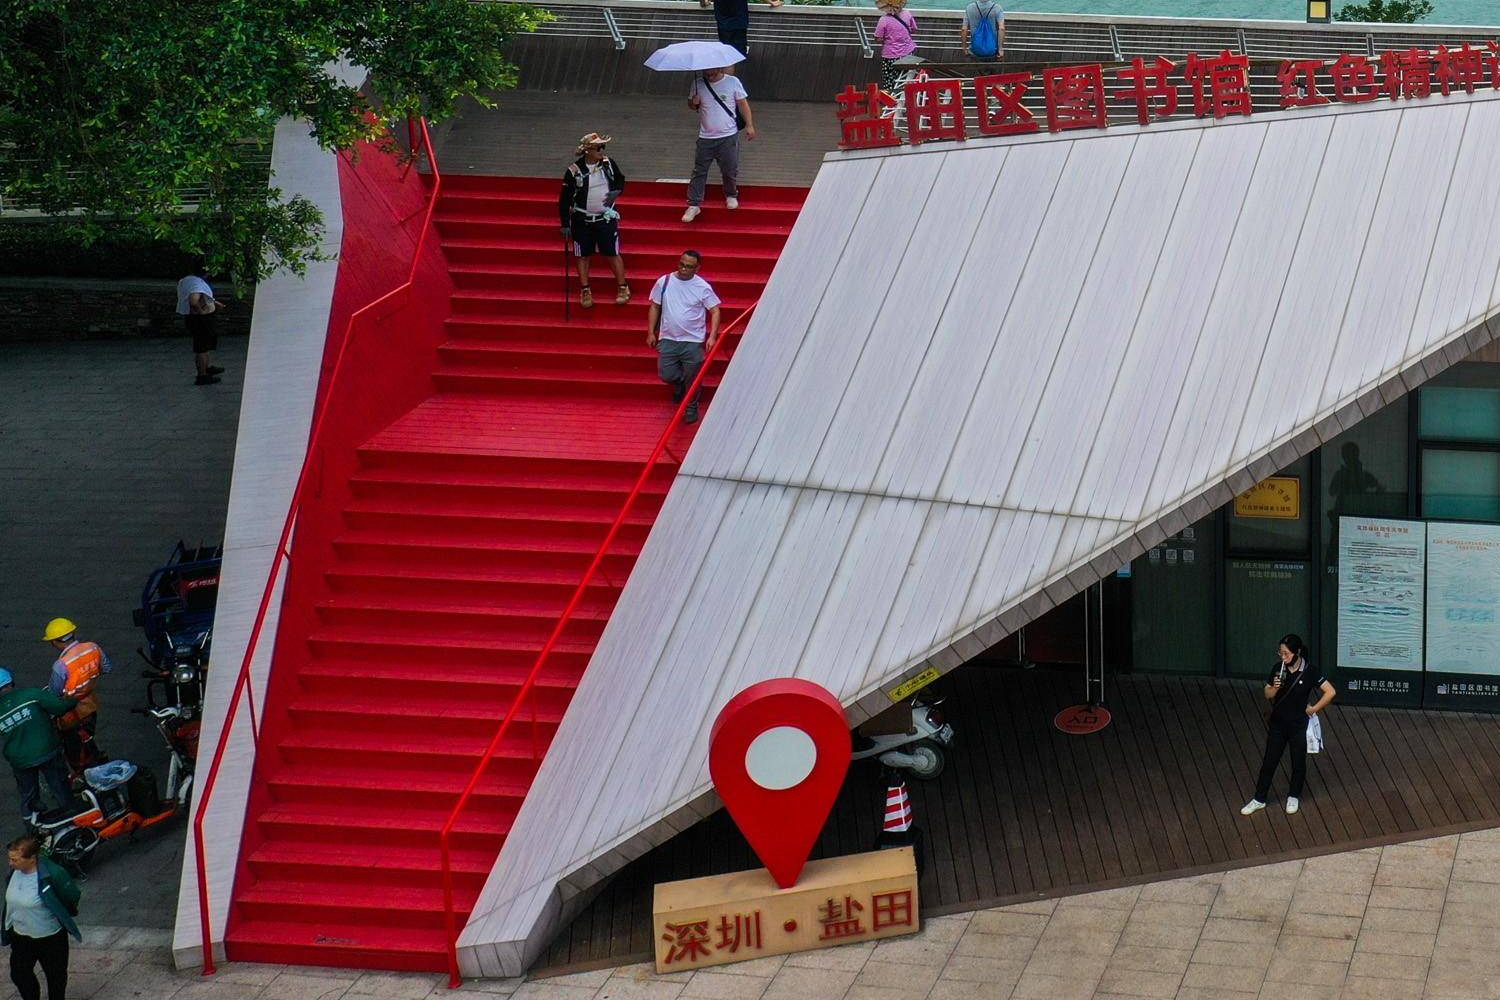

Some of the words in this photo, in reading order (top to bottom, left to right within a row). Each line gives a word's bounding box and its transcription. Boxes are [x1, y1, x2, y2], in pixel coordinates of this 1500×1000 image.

[835, 49, 1253, 150] 盐田区图书馆
